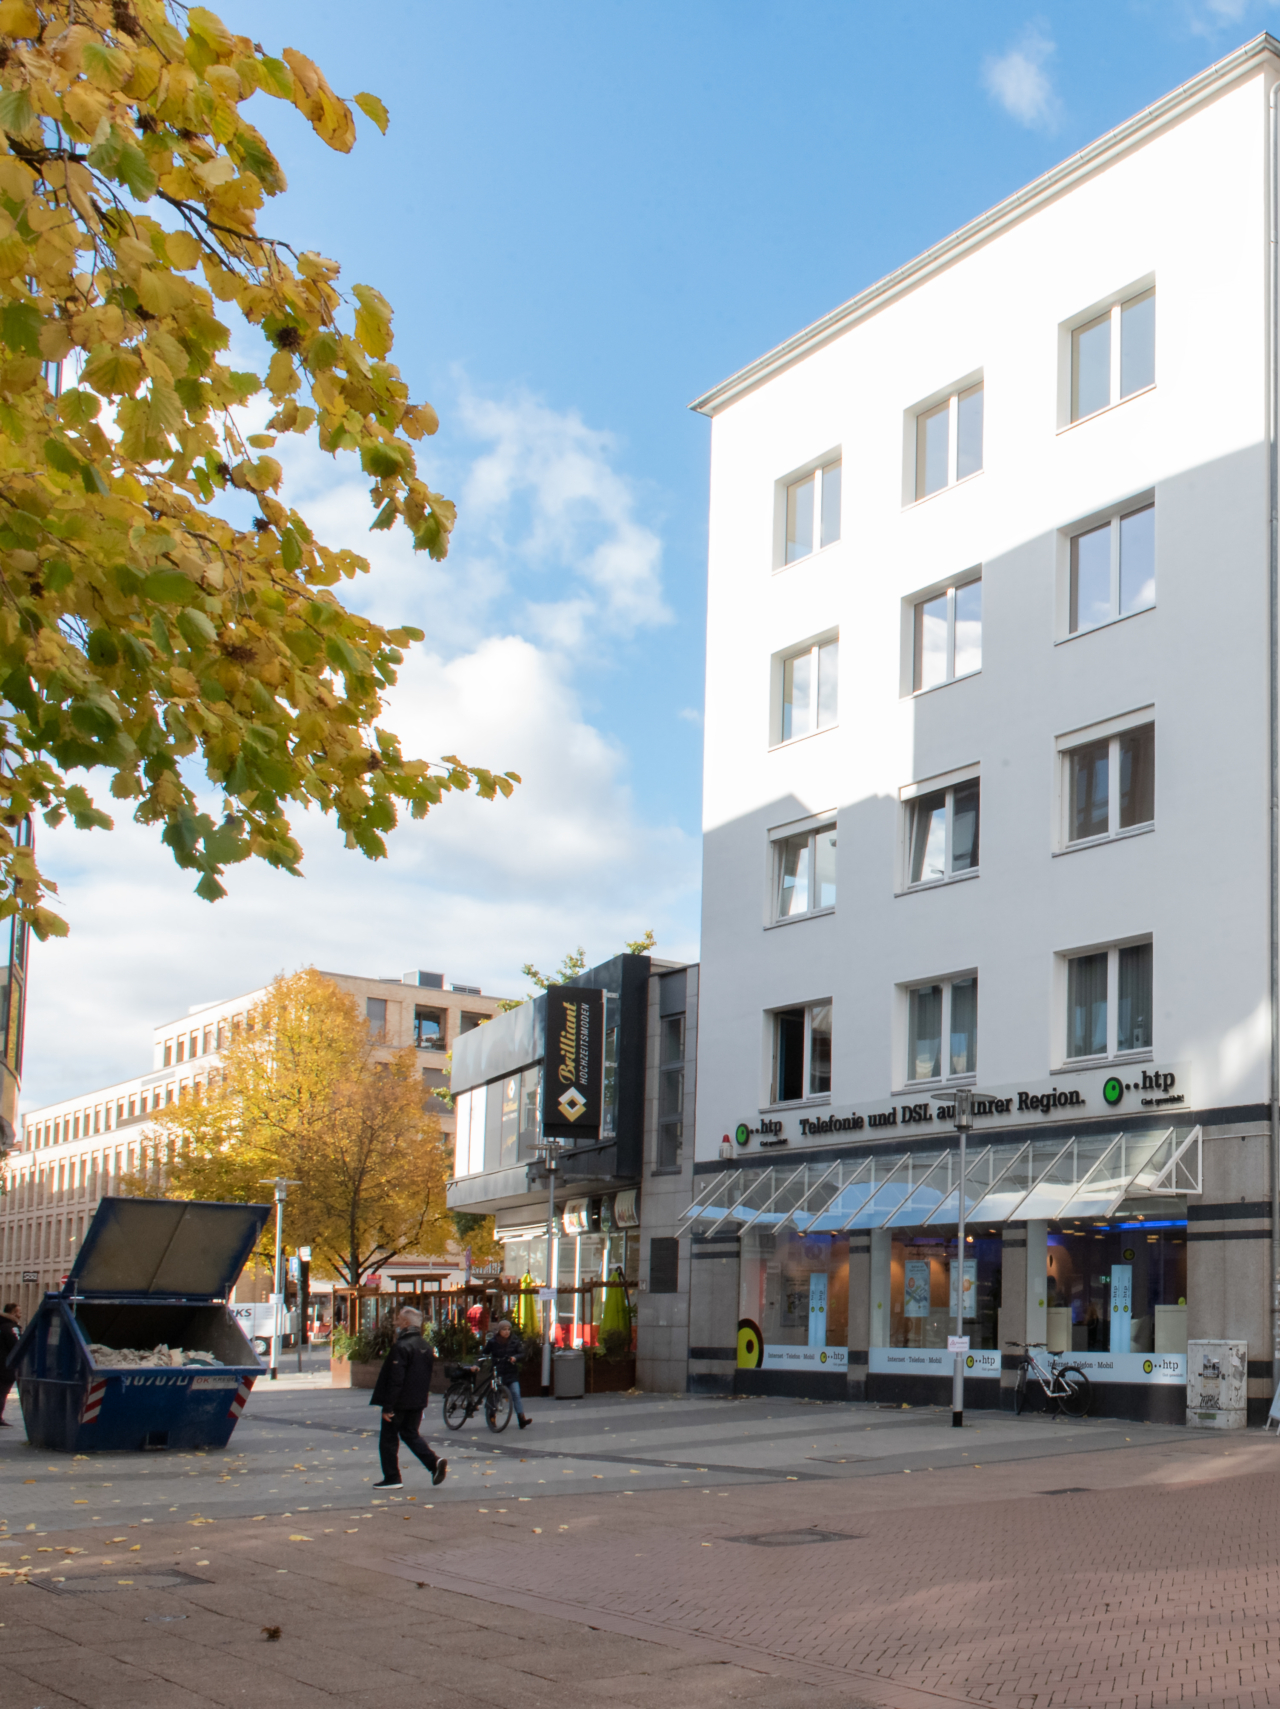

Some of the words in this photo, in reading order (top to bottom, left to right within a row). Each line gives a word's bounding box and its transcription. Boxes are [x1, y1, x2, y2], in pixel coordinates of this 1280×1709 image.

[559, 1001, 578, 1084] Brilliant
[579, 1003, 590, 1085] HOCHZEITSMODEN
[1141, 1070, 1175, 1092] htp
[800, 1112, 864, 1136] Telefonie
[868, 1107, 897, 1127] und
[901, 1103, 932, 1123] DSL
[937, 1104, 957, 1120] au
[1017, 1088, 1086, 1114] Region.
[760, 1119, 782, 1136] htp
[833, 1351, 845, 1361] htp
[982, 1355, 995, 1366] htp
[1097, 1361, 1114, 1369] Mobil
[1162, 1359, 1178, 1371] htp
